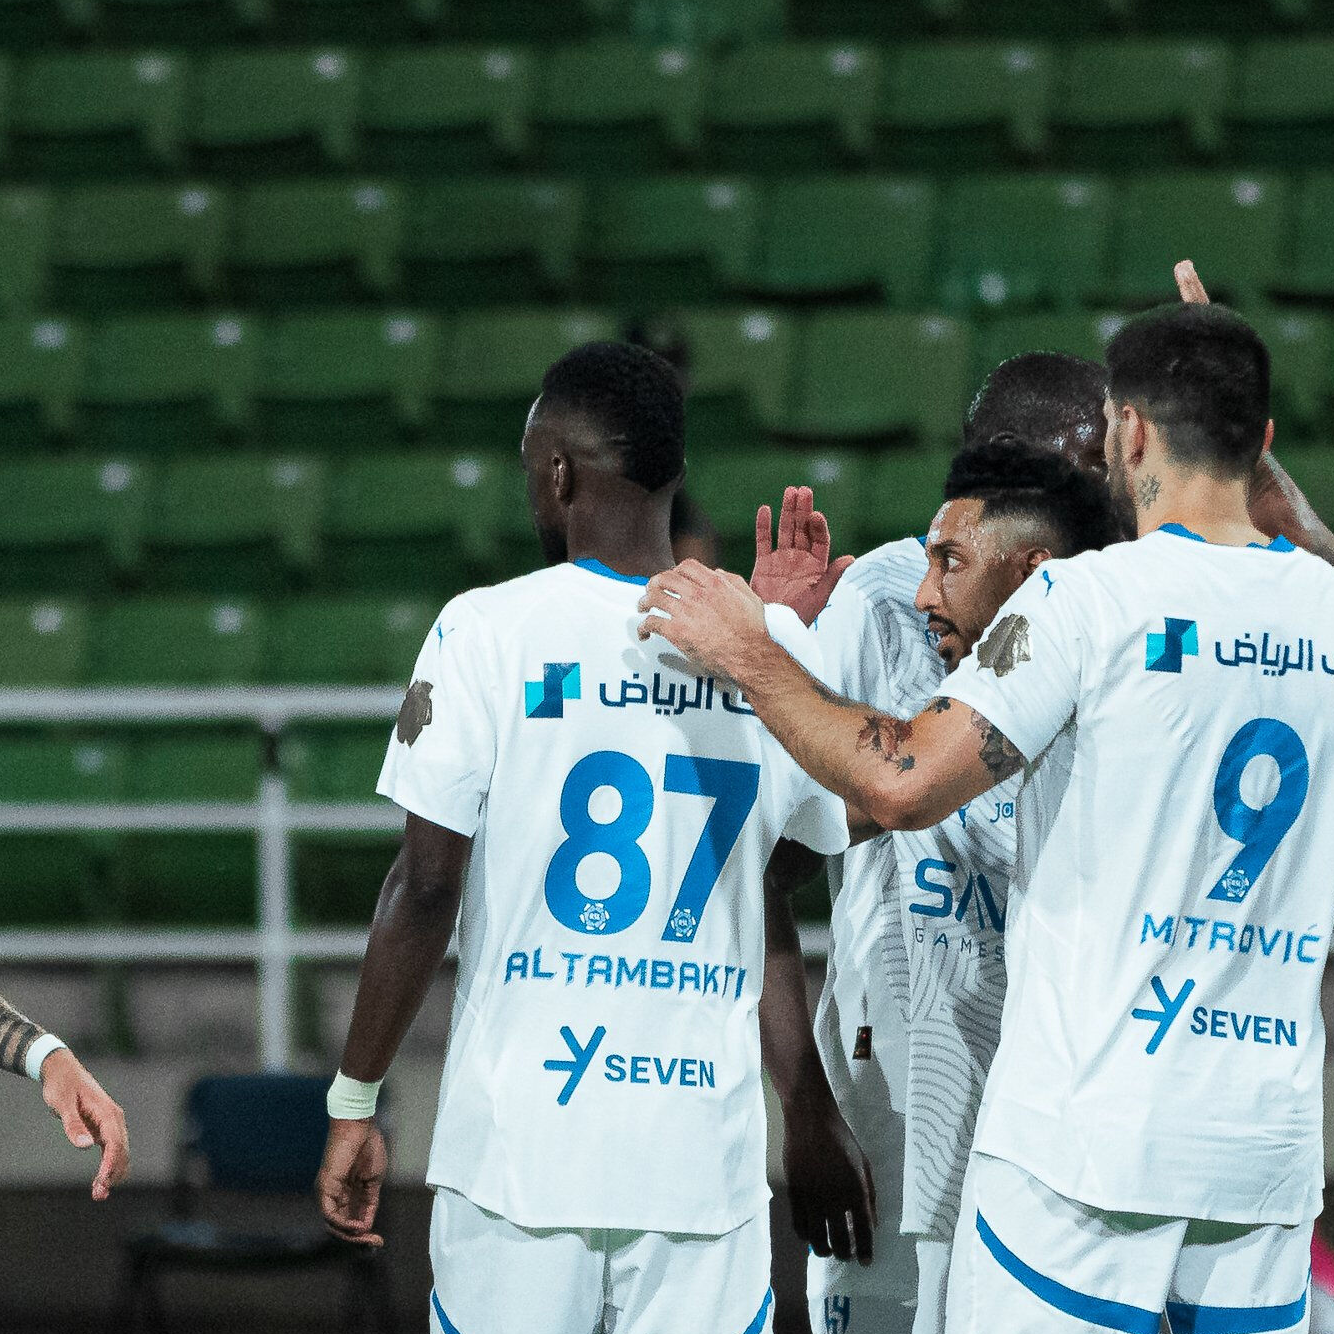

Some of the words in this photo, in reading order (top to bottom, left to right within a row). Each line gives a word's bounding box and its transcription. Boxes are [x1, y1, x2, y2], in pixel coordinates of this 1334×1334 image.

[1215, 632, 1314, 677] الرياض
[599, 672, 715, 716] الرياض
[1207, 717, 1309, 903] 9
[544, 750, 762, 944] 87
[914, 927, 1005, 962] GAMES
[1190, 1005, 1298, 1047] SEVEN
[603, 1053, 716, 1089] SEVEN
